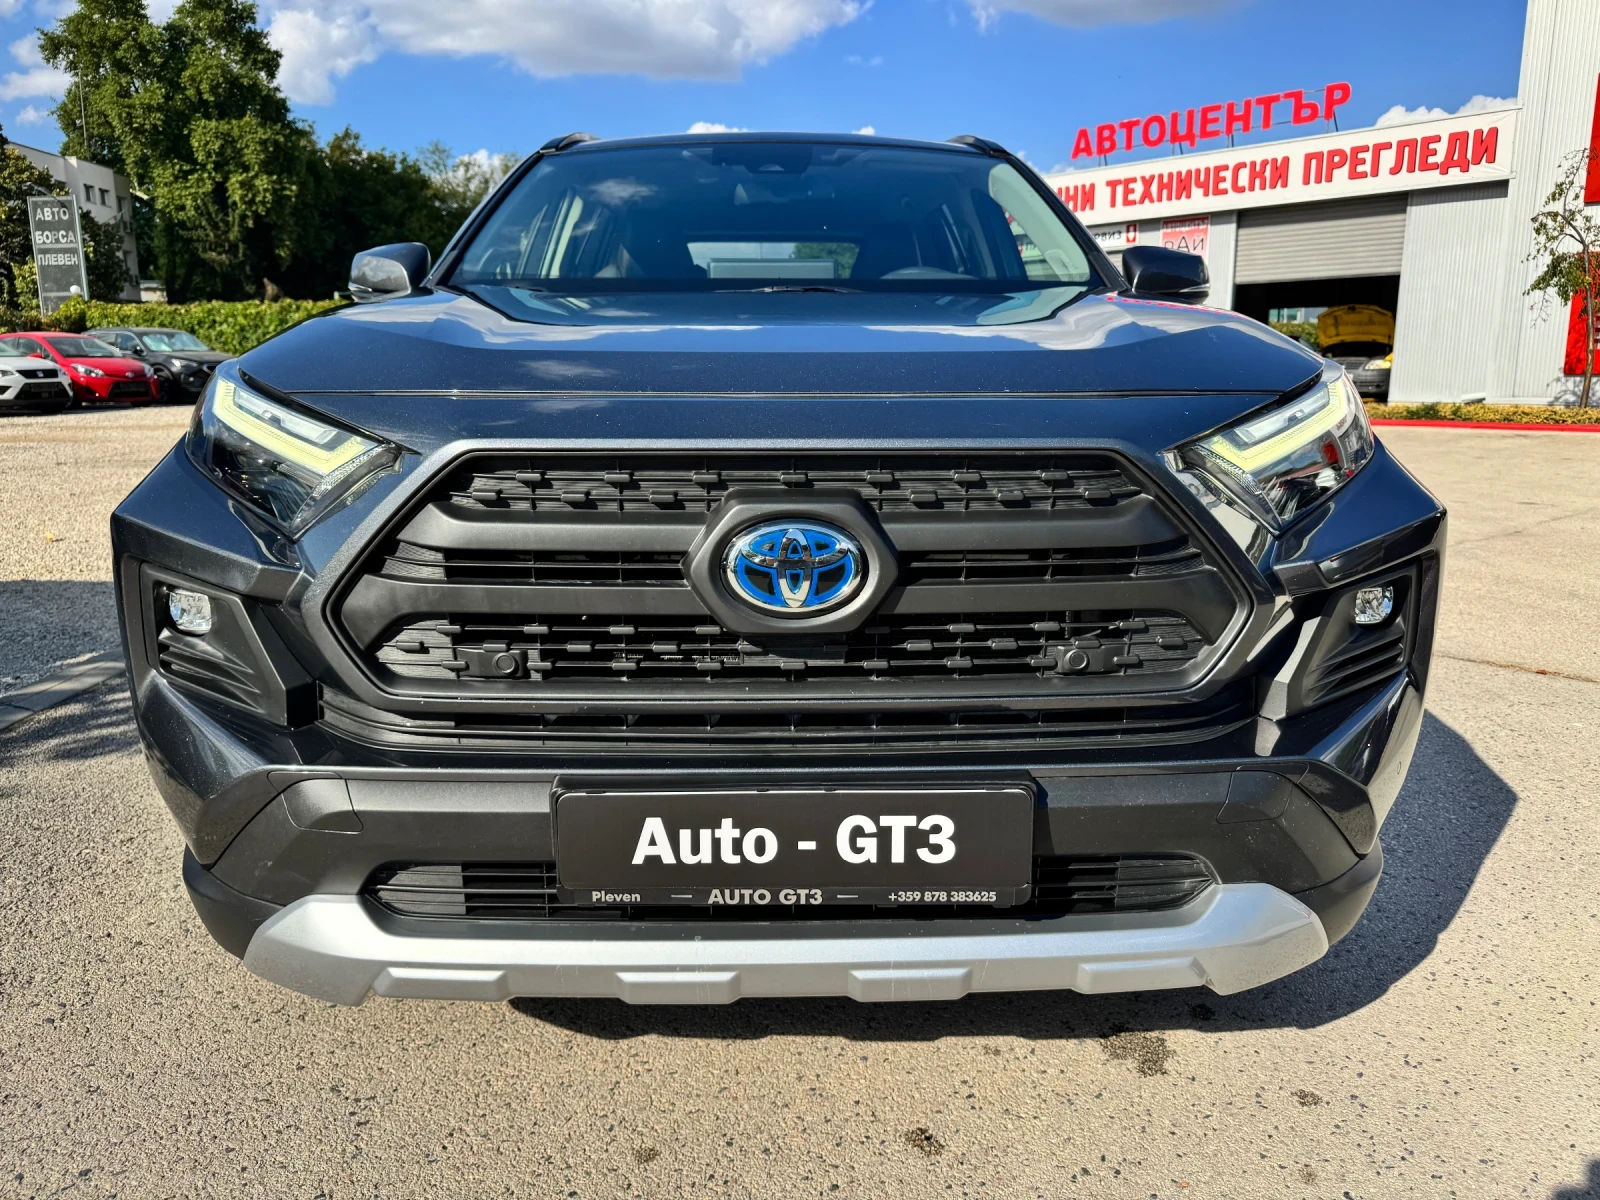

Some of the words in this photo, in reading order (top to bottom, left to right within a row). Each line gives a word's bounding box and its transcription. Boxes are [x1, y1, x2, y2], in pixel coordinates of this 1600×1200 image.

[1070, 81, 1352, 160] АВТОЦЕНТЪР
[1106, 155, 1290, 208] ТЕХНИЧЕСКИ
[1302, 126, 1499, 185] ПРЕГЛЕДИ
[35, 207, 69, 221] АВТО
[35, 230, 76, 244] БОРСА
[37, 253, 79, 266] ПЛЕВЕН
[631, 816, 779, 866] Auto
[836, 814, 958, 865] GT3
[591, 890, 642, 902] Pleven
[707, 888, 772, 905] AUTO
[778, 888, 823, 905] GT3
[888, 891, 921, 902] +359
[923, 891, 948, 902] 878
[950, 891, 997, 902] 383625
